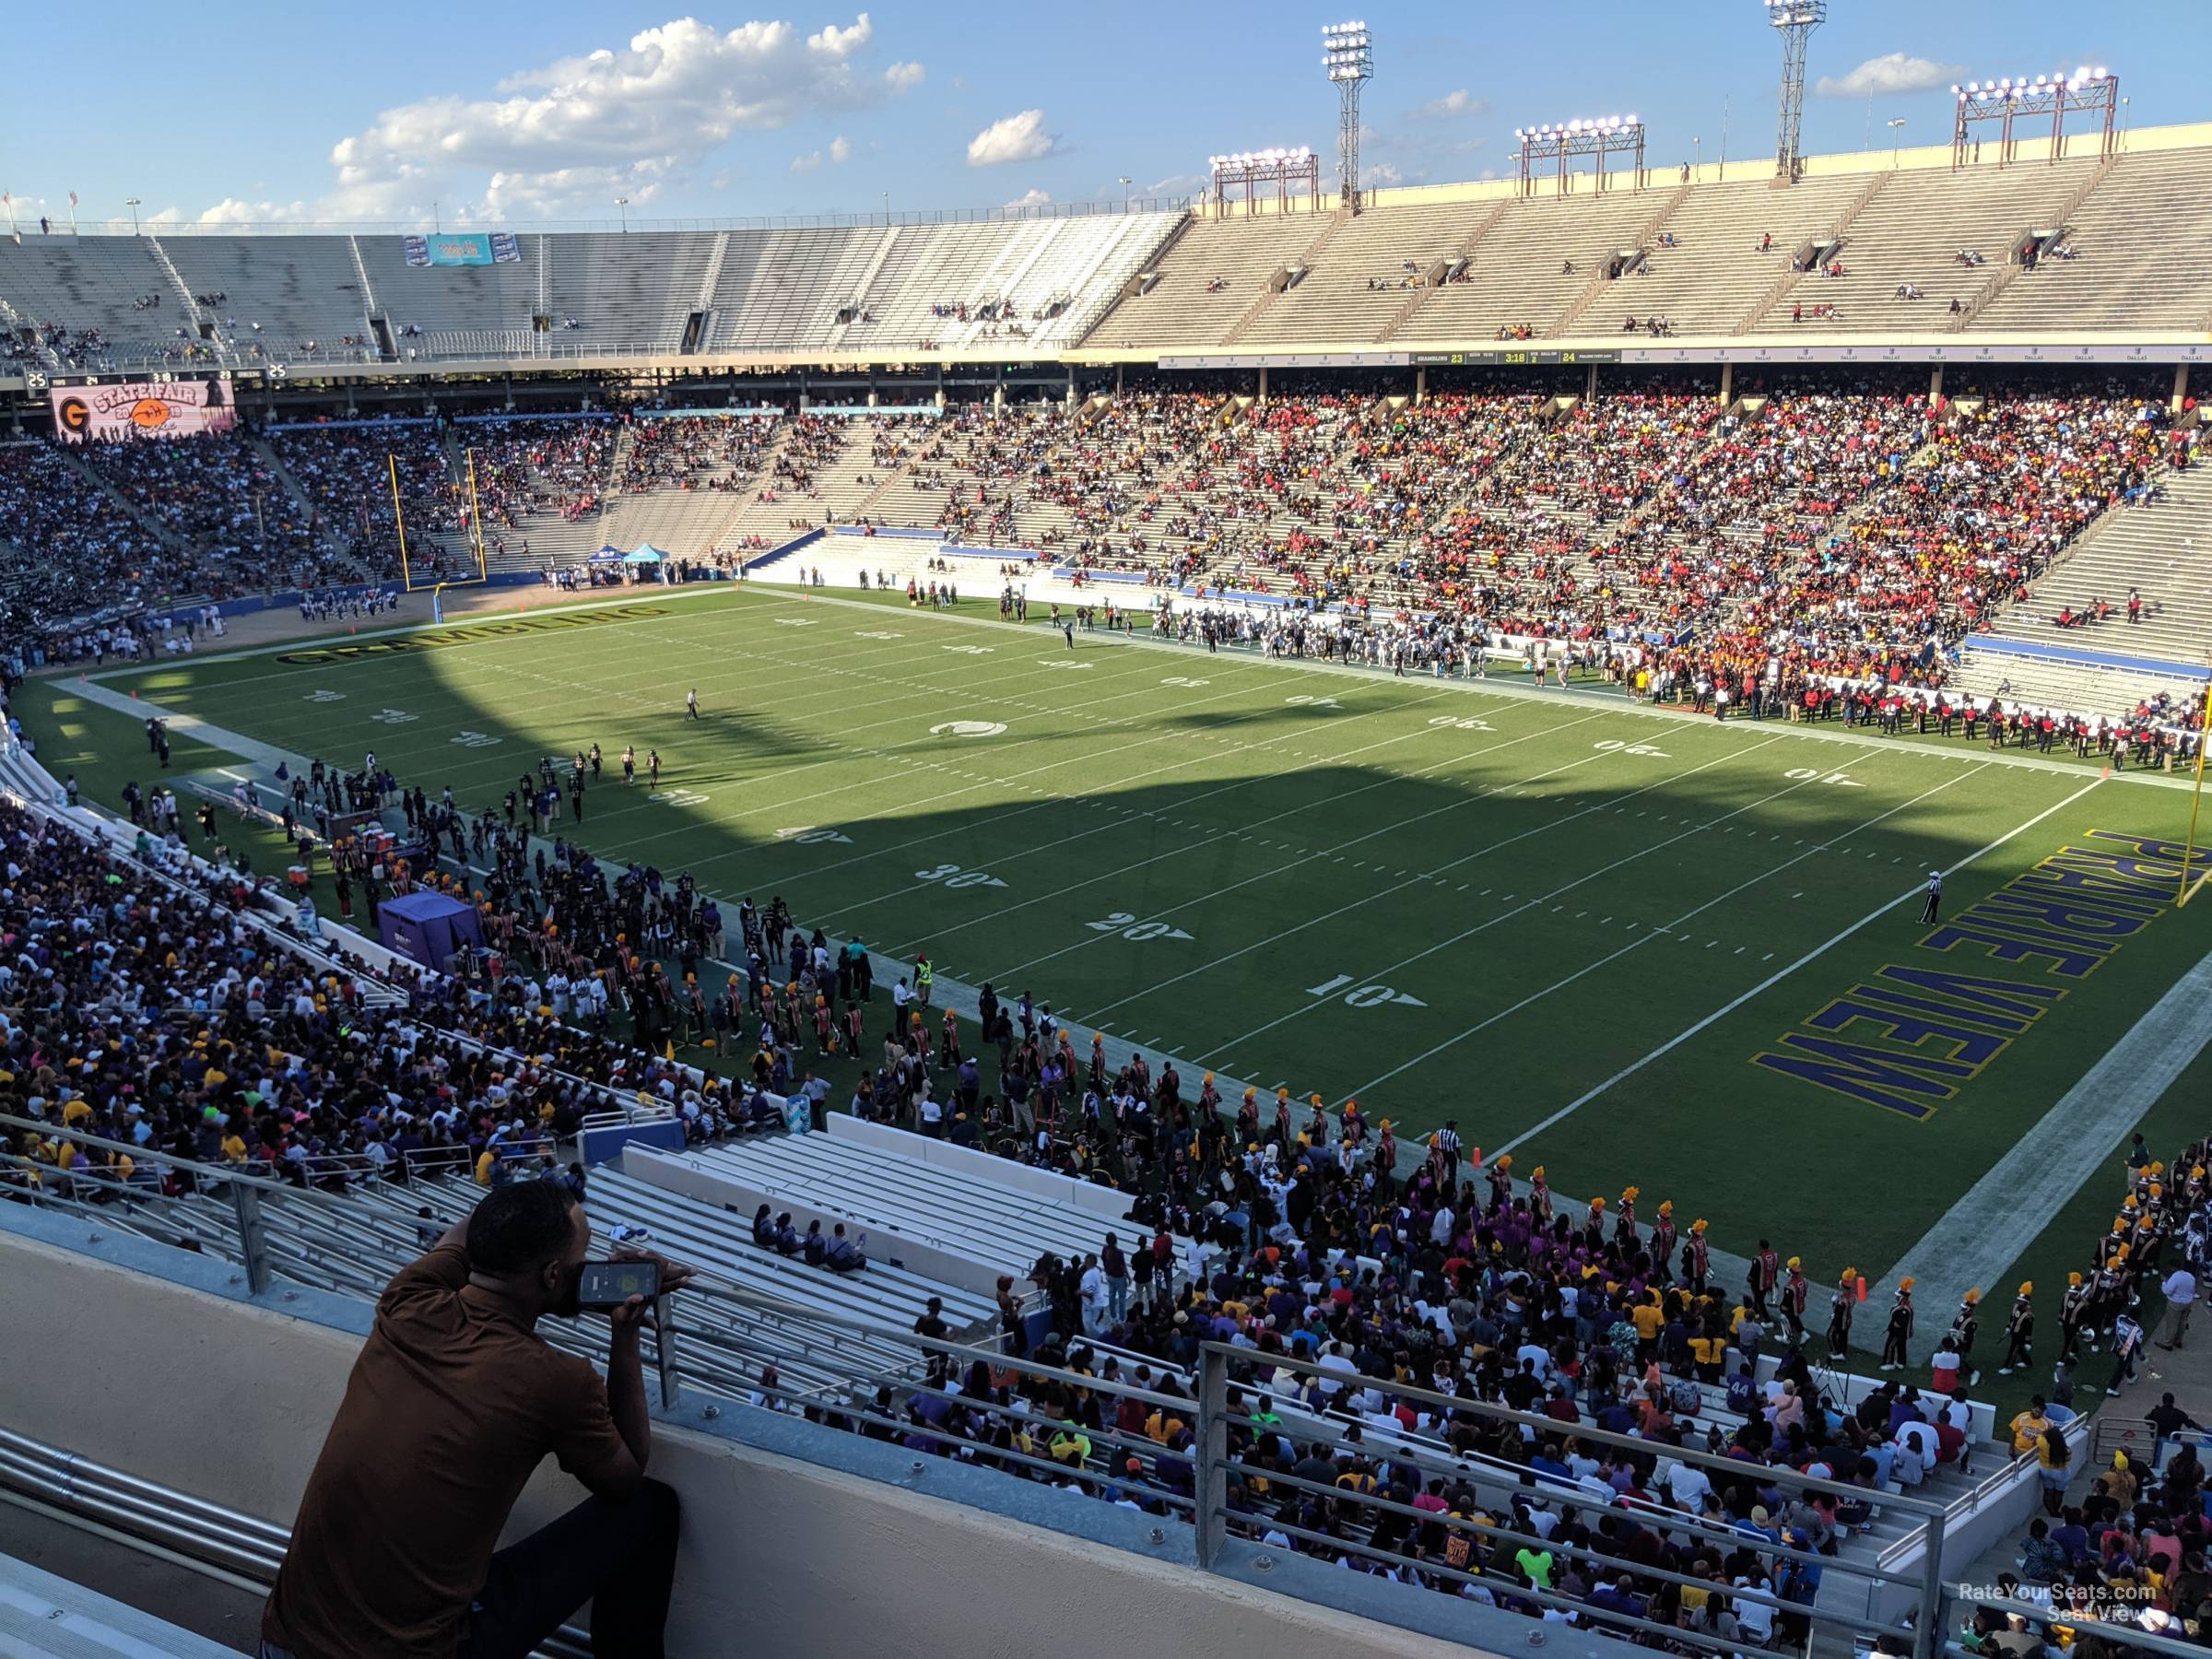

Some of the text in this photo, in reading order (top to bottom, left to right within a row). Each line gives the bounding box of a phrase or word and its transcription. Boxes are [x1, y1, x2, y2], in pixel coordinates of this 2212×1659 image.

[1451, 354, 1464, 363] 23
[1505, 353, 1525, 363] 3:18
[1563, 353, 1575, 362] 24
[153, 372, 171, 383] 3:18
[220, 371, 231, 380] 23
[269, 364, 286, 378] 25
[29, 372, 46, 387] 25
[87, 376, 99, 386] 24
[93, 382, 196, 413] STATE FAIR
[115, 408, 130, 419] 20
[276, 606, 675, 665] GRAMBLING
[1159, 677, 1210, 688] 50
[1594, 739, 1662, 758] 20
[1783, 768, 1850, 784] 10
[647, 789, 711, 807] 50
[914, 864, 990, 888] 30
[1085, 912, 1171, 941] 20
[1749, 828, 2212, 1123] PRAIRIE VIEW
[1305, 974, 1395, 1007] 10
[1731, 1381, 1749, 1398] 44
